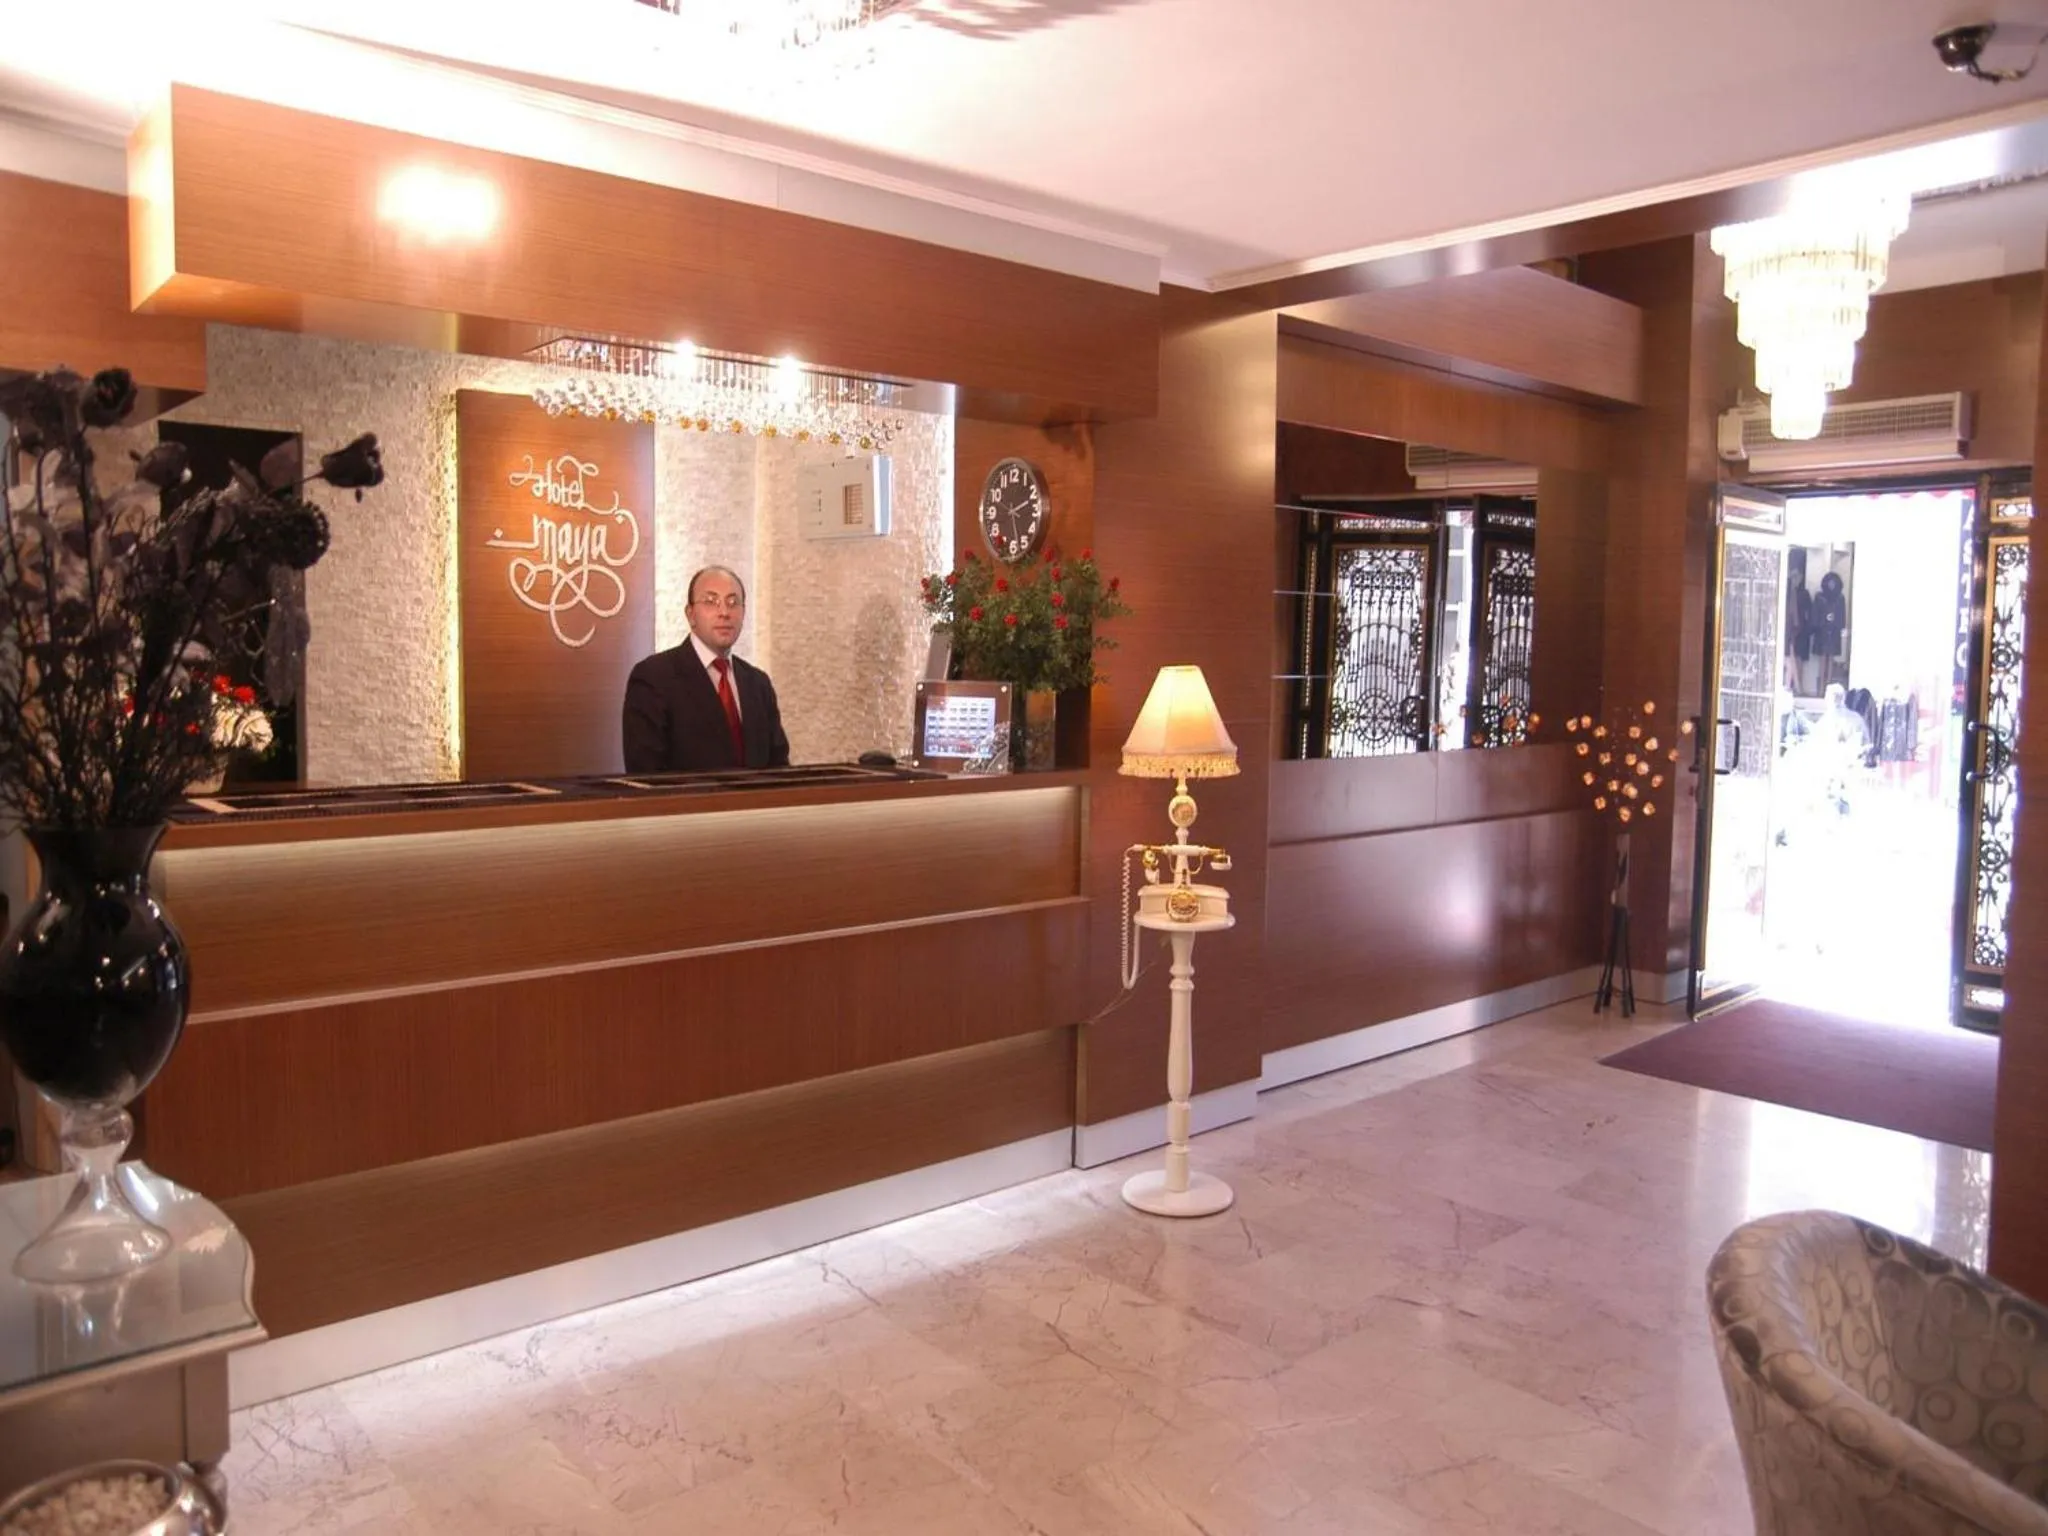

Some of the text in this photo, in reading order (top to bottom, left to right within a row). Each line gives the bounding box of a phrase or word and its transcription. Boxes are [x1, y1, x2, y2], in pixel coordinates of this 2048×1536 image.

[1000, 471, 1007, 489] 11
[1009, 468, 1019, 483] 12
[1023, 472, 1028, 486] 1
[509, 455, 620, 515] Hotel
[1029, 484, 1037, 500] 2
[990, 488, 1002, 503] 10
[988, 506, 997, 520] 9
[1032, 503, 1040, 518] 3
[991, 522, 1000, 537] 8
[1027, 520, 1036, 534] 4
[1009, 540, 1018, 554] 6
[1020, 535, 1028, 549] 5
